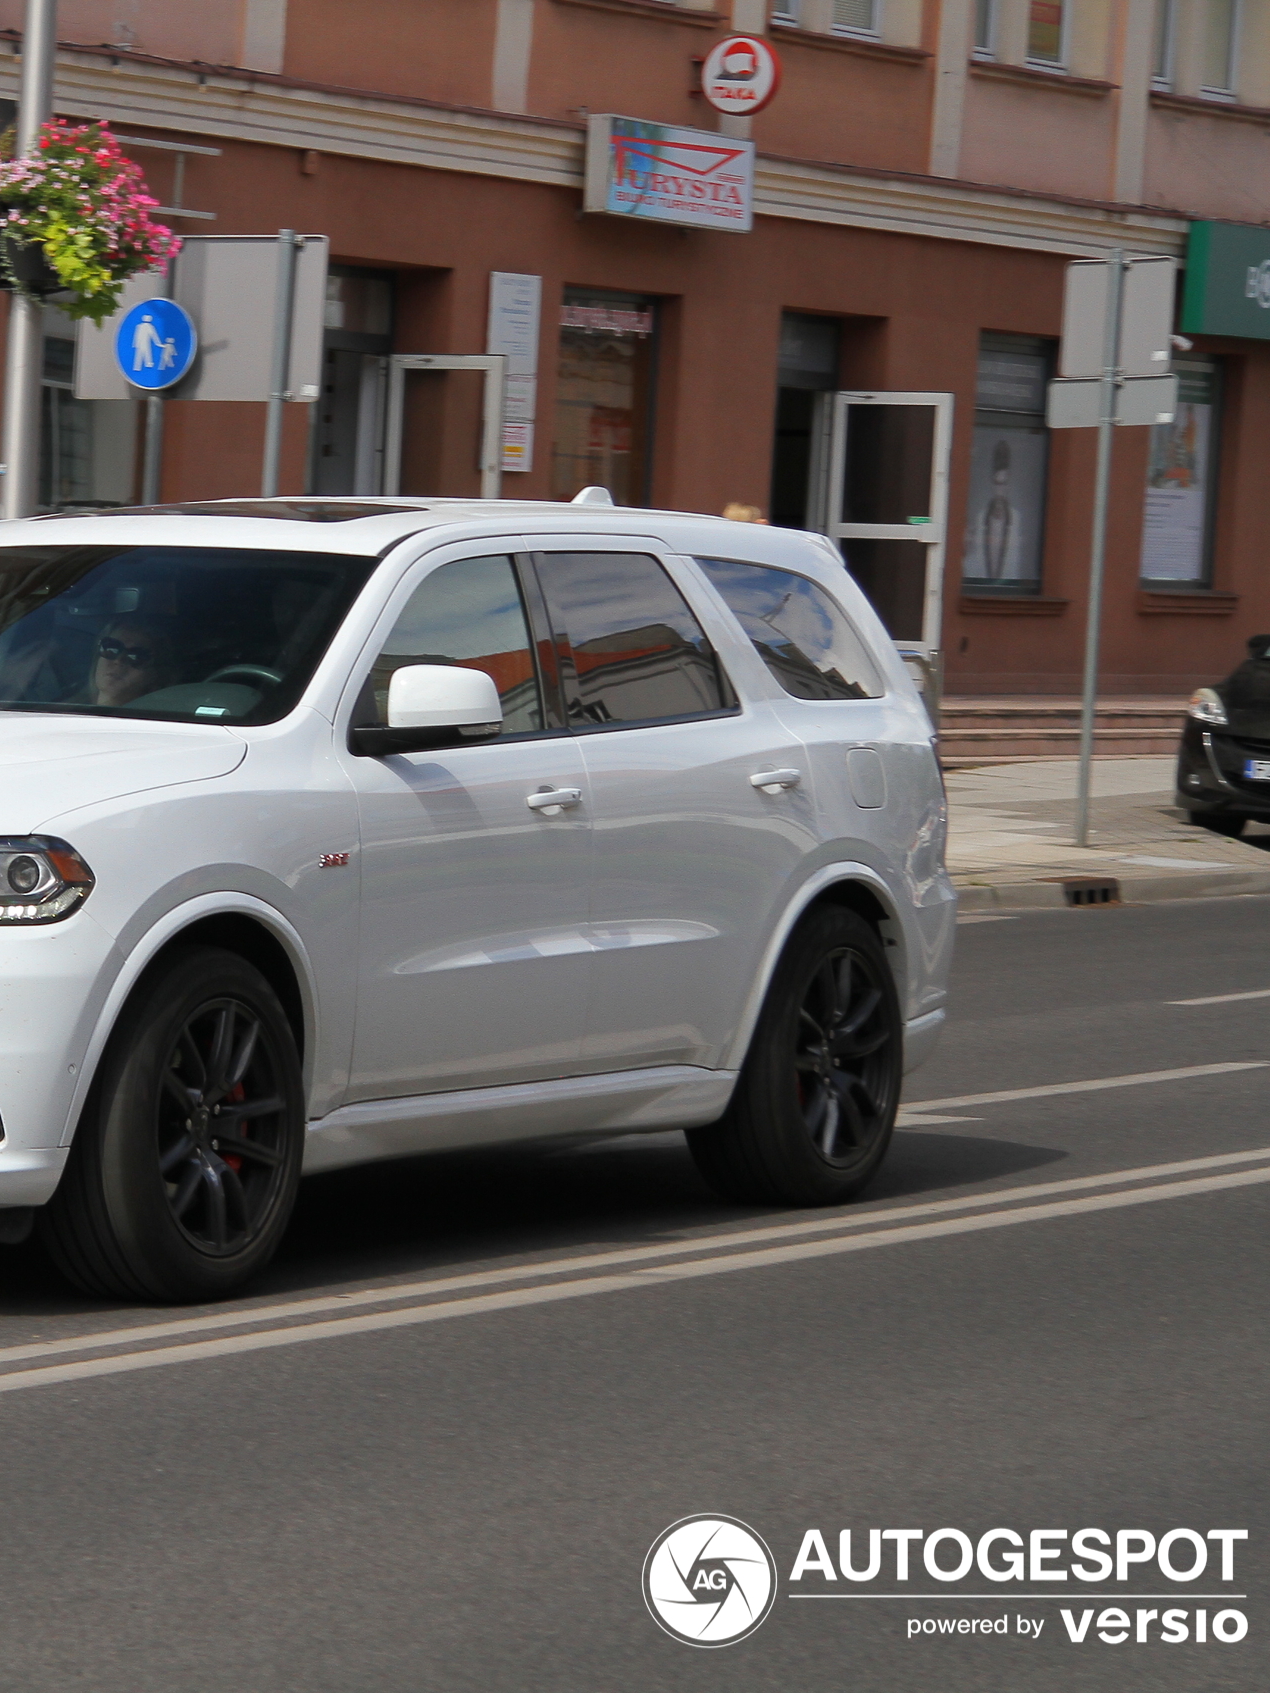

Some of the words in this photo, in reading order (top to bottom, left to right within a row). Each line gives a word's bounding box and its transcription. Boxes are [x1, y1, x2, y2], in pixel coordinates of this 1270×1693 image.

[711, 86, 758, 100] ITAKA
[613, 140, 744, 205] TURYSTA
[615, 191, 655, 206] BIURO
